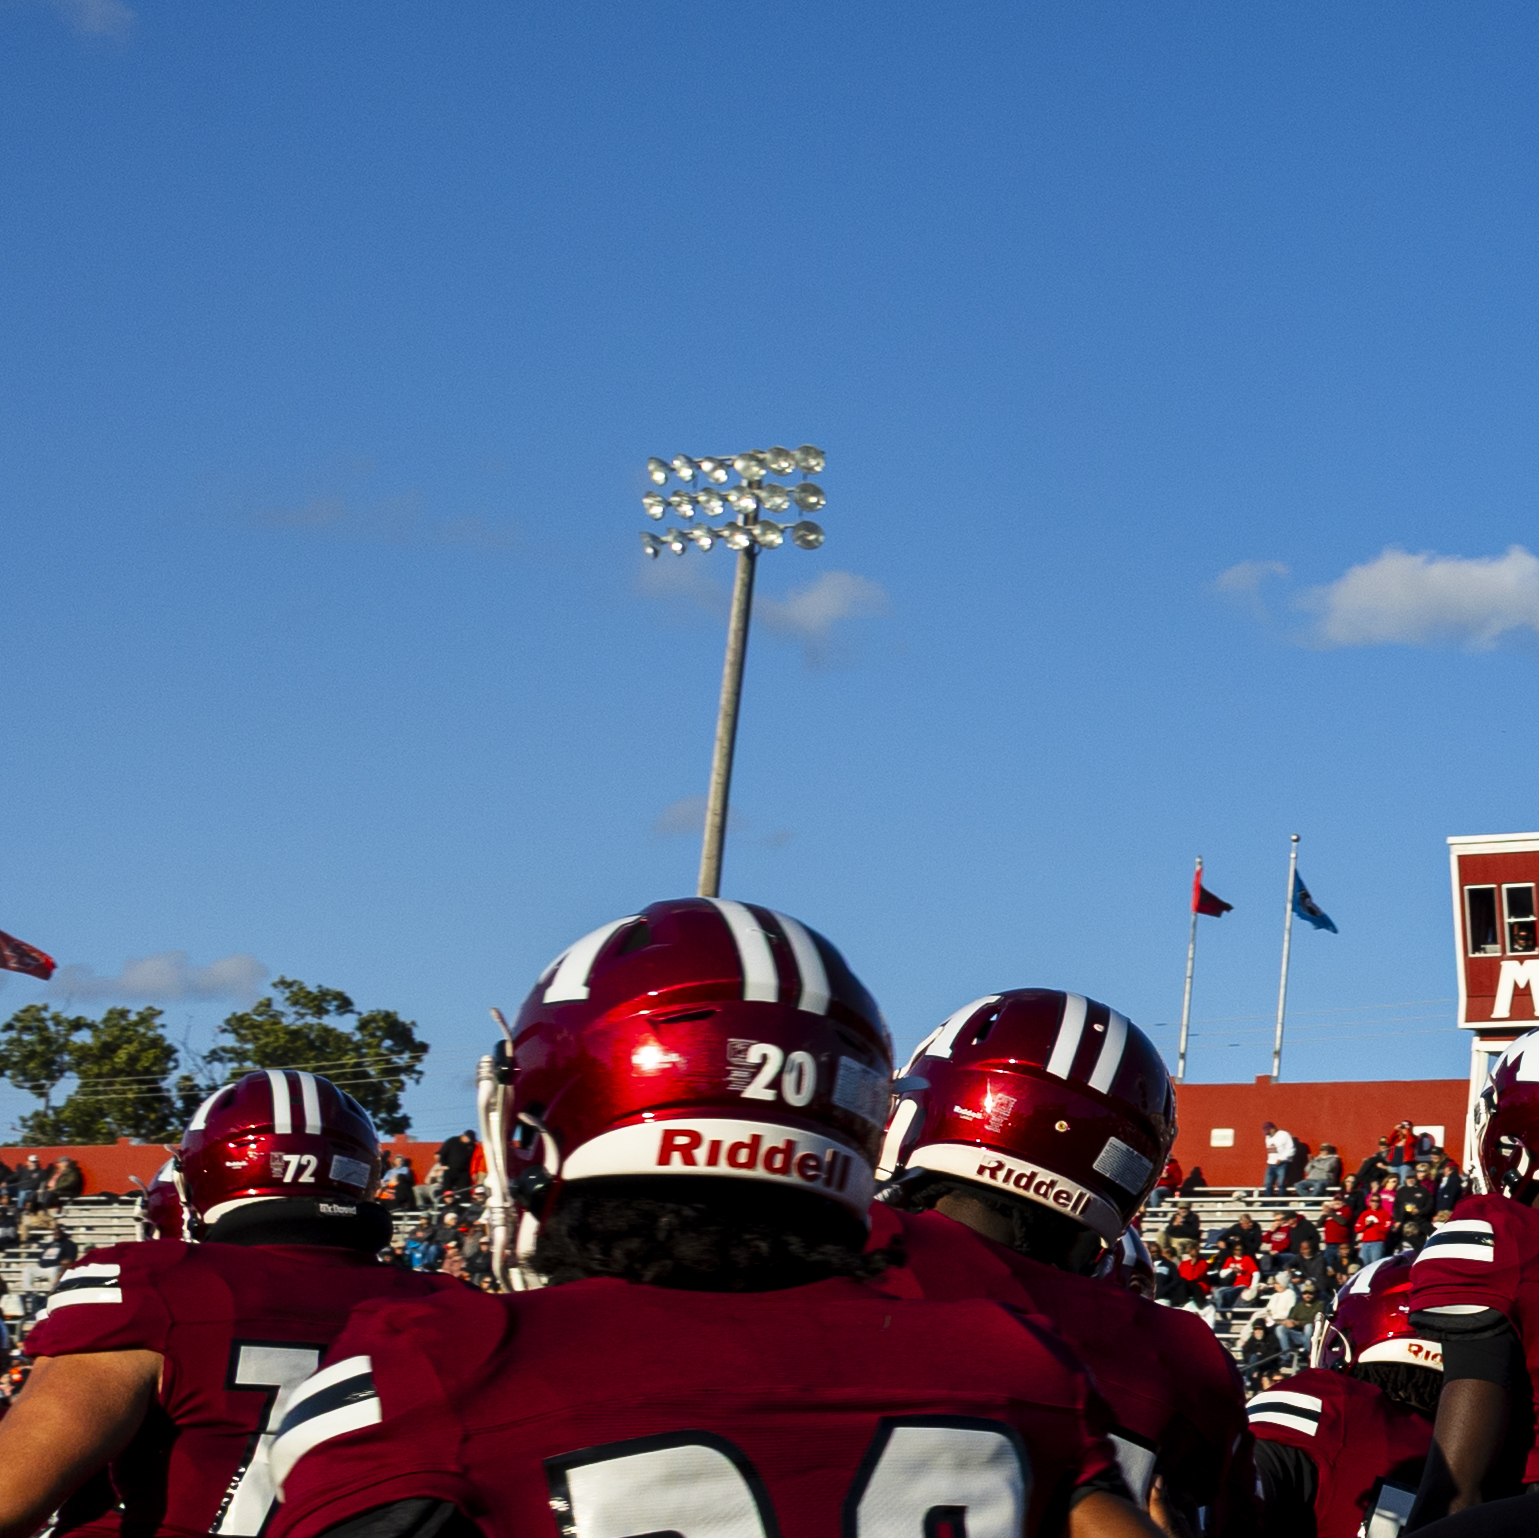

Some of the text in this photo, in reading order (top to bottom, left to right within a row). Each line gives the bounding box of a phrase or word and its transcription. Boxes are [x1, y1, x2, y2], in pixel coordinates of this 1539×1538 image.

[740, 1042, 818, 1107] 20
[282, 1154, 318, 1183] 72
[655, 1128, 853, 1193] Riddell
[976, 1155, 1094, 1217] Riddell
